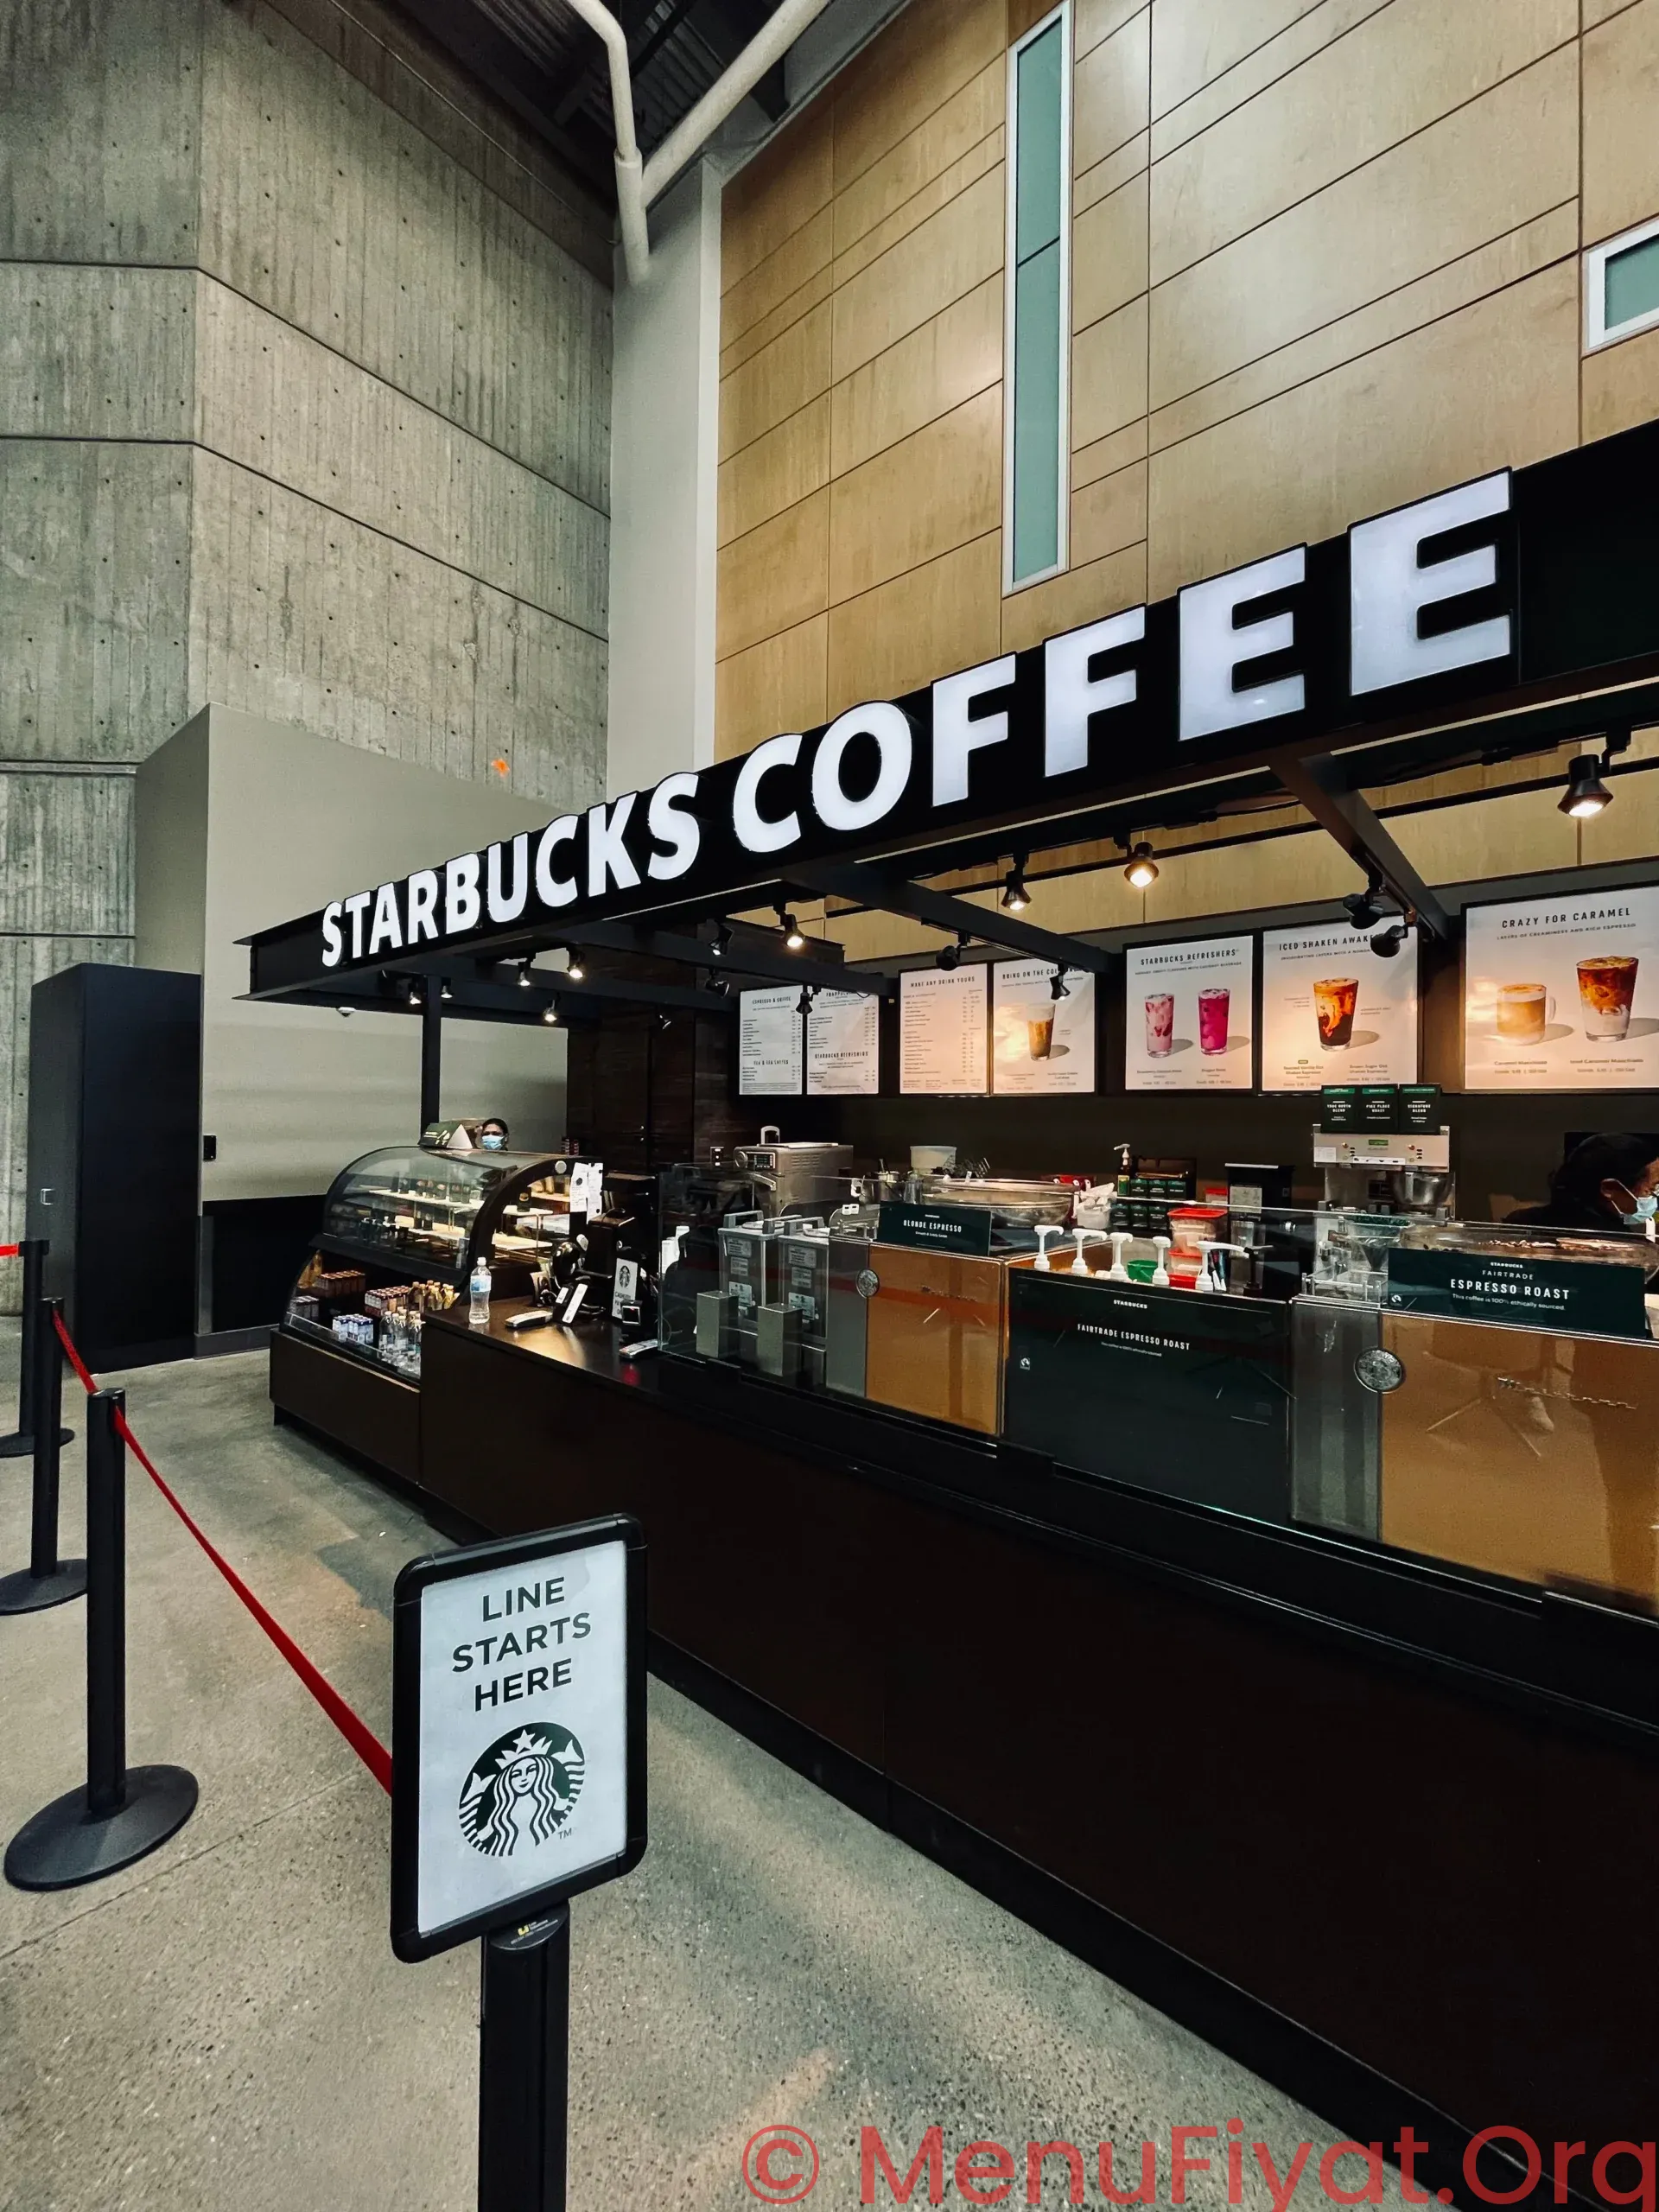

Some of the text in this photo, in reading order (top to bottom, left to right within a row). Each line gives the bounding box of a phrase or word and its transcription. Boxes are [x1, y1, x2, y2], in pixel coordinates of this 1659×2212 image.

[321, 469, 1511, 967] STARBUCKS COFFEE
[1502, 907, 1630, 928] CRAZY FOR CARAMEL
[1279, 942, 1299, 951] ICED
[1302, 938, 1338, 949] SHAKEN
[1141, 955, 1184, 965] STARBUCKS
[903, 1219, 962, 1233] BLONDE ESPRESSO
[1482, 1269, 1534, 1281] FAIRTRADE
[1450, 1278, 1570, 1300] ESPRESSO ROAST
[1113, 1299, 1147, 1309] STARBUCKS
[1510, 1300, 1537, 1308] ethically
[1077, 1323, 1117, 1338] FAIRTRADE
[1121, 1331, 1160, 1345] ESPRESSO
[1163, 1338, 1190, 1351] ROAST
[482, 1576, 566, 1623] LINE
[452, 1611, 592, 1673] STARTS
[474, 1657, 572, 1713] HERE
[558, 1827, 572, 1840] TM
